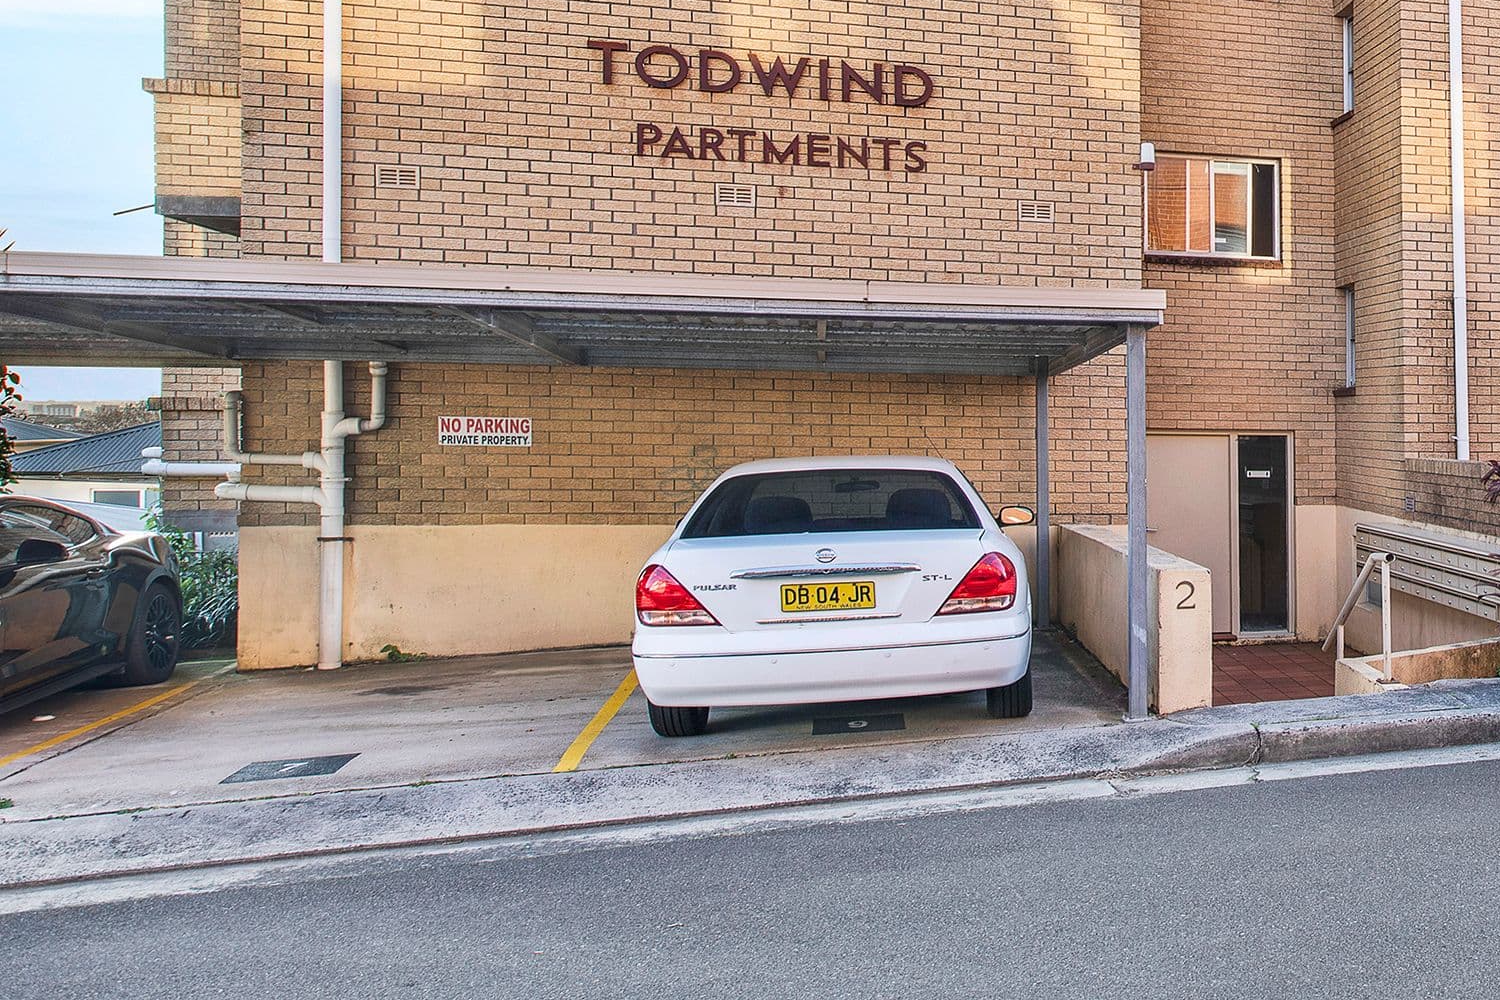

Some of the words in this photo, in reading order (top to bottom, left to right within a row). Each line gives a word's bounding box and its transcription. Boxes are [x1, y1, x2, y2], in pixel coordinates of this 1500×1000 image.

[586, 39, 934, 108] TODWIND
[635, 122, 928, 174] PARTMENTS
[440, 418, 461, 433] NO
[466, 418, 530, 434] PARKING
[441, 435, 479, 445] PRIVATE
[481, 435, 529, 445] PROPERTY
[922, 574, 953, 582] ST-L
[1175, 580, 1196, 611] 2
